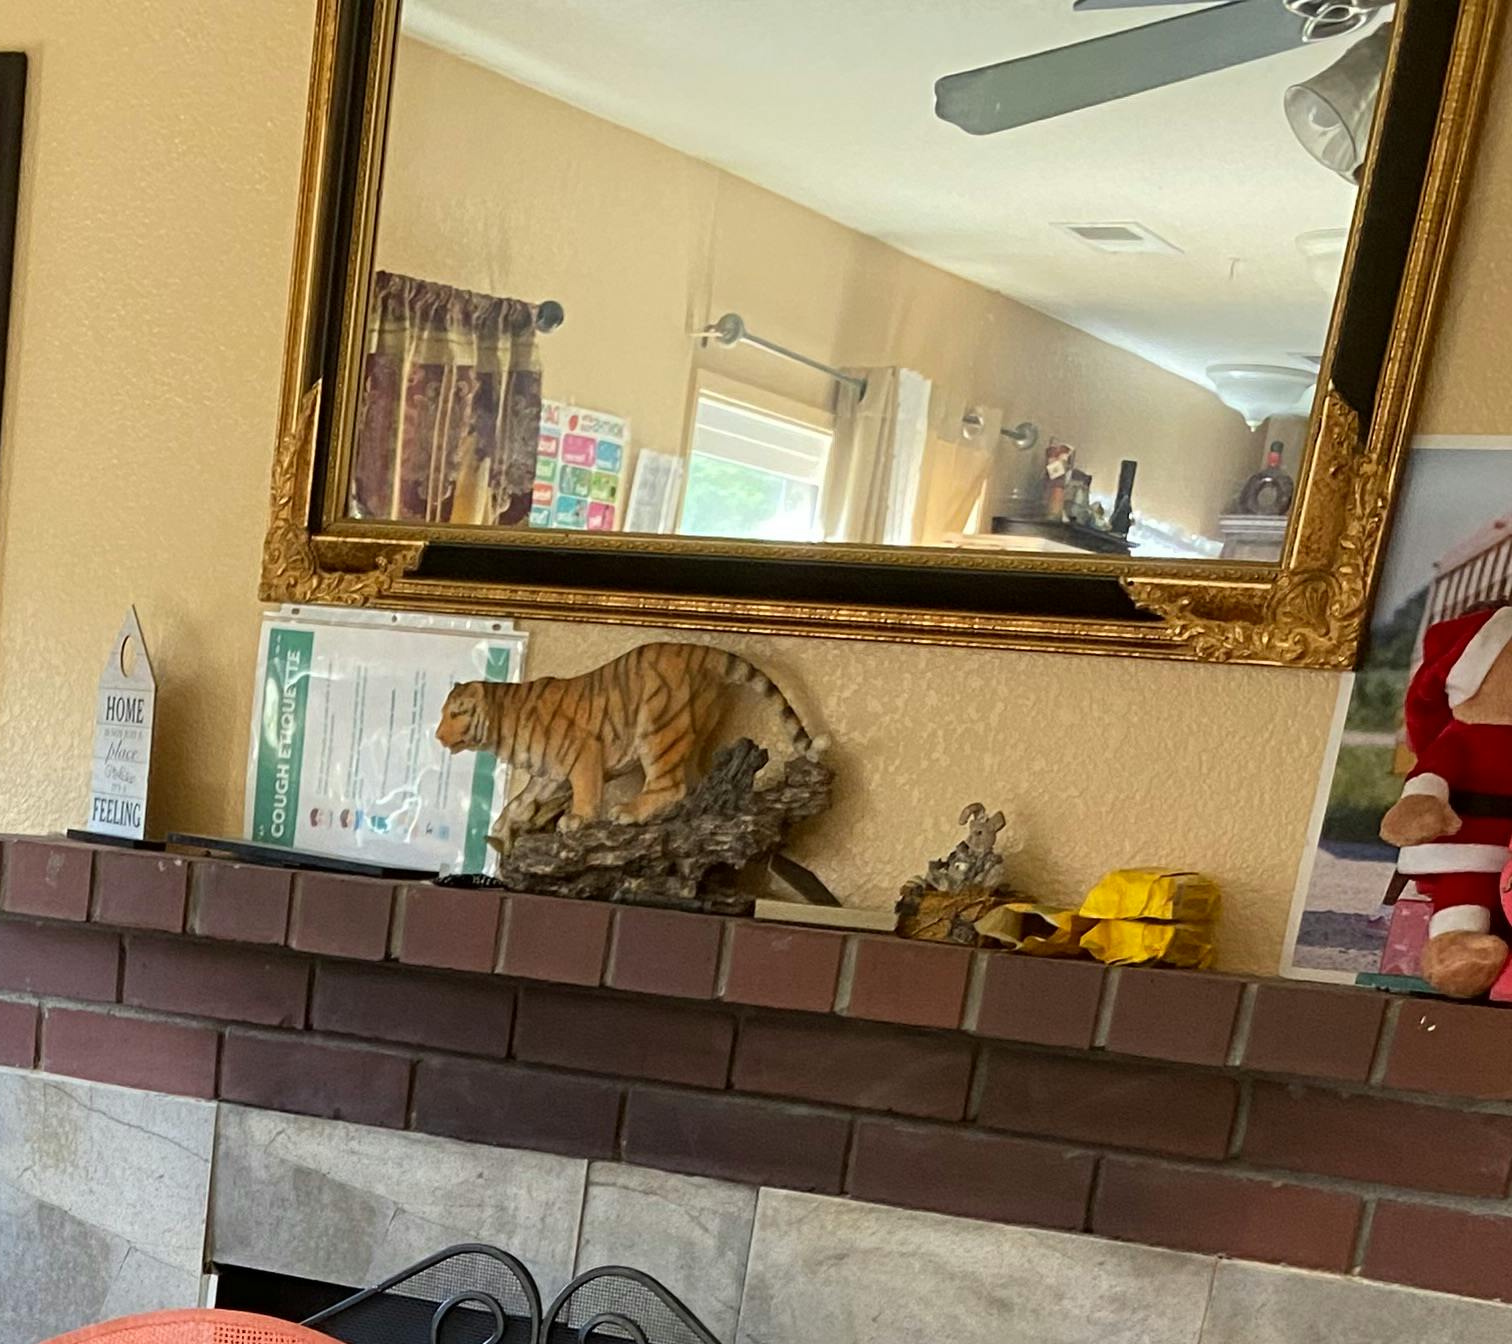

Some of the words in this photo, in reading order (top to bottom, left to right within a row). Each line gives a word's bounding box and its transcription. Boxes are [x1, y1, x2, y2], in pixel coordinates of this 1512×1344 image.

[105, 695, 145, 724] HOME
[104, 739, 138, 766] place
[92, 797, 141, 829] FEELING
[271, 764, 290, 838] COUGH
